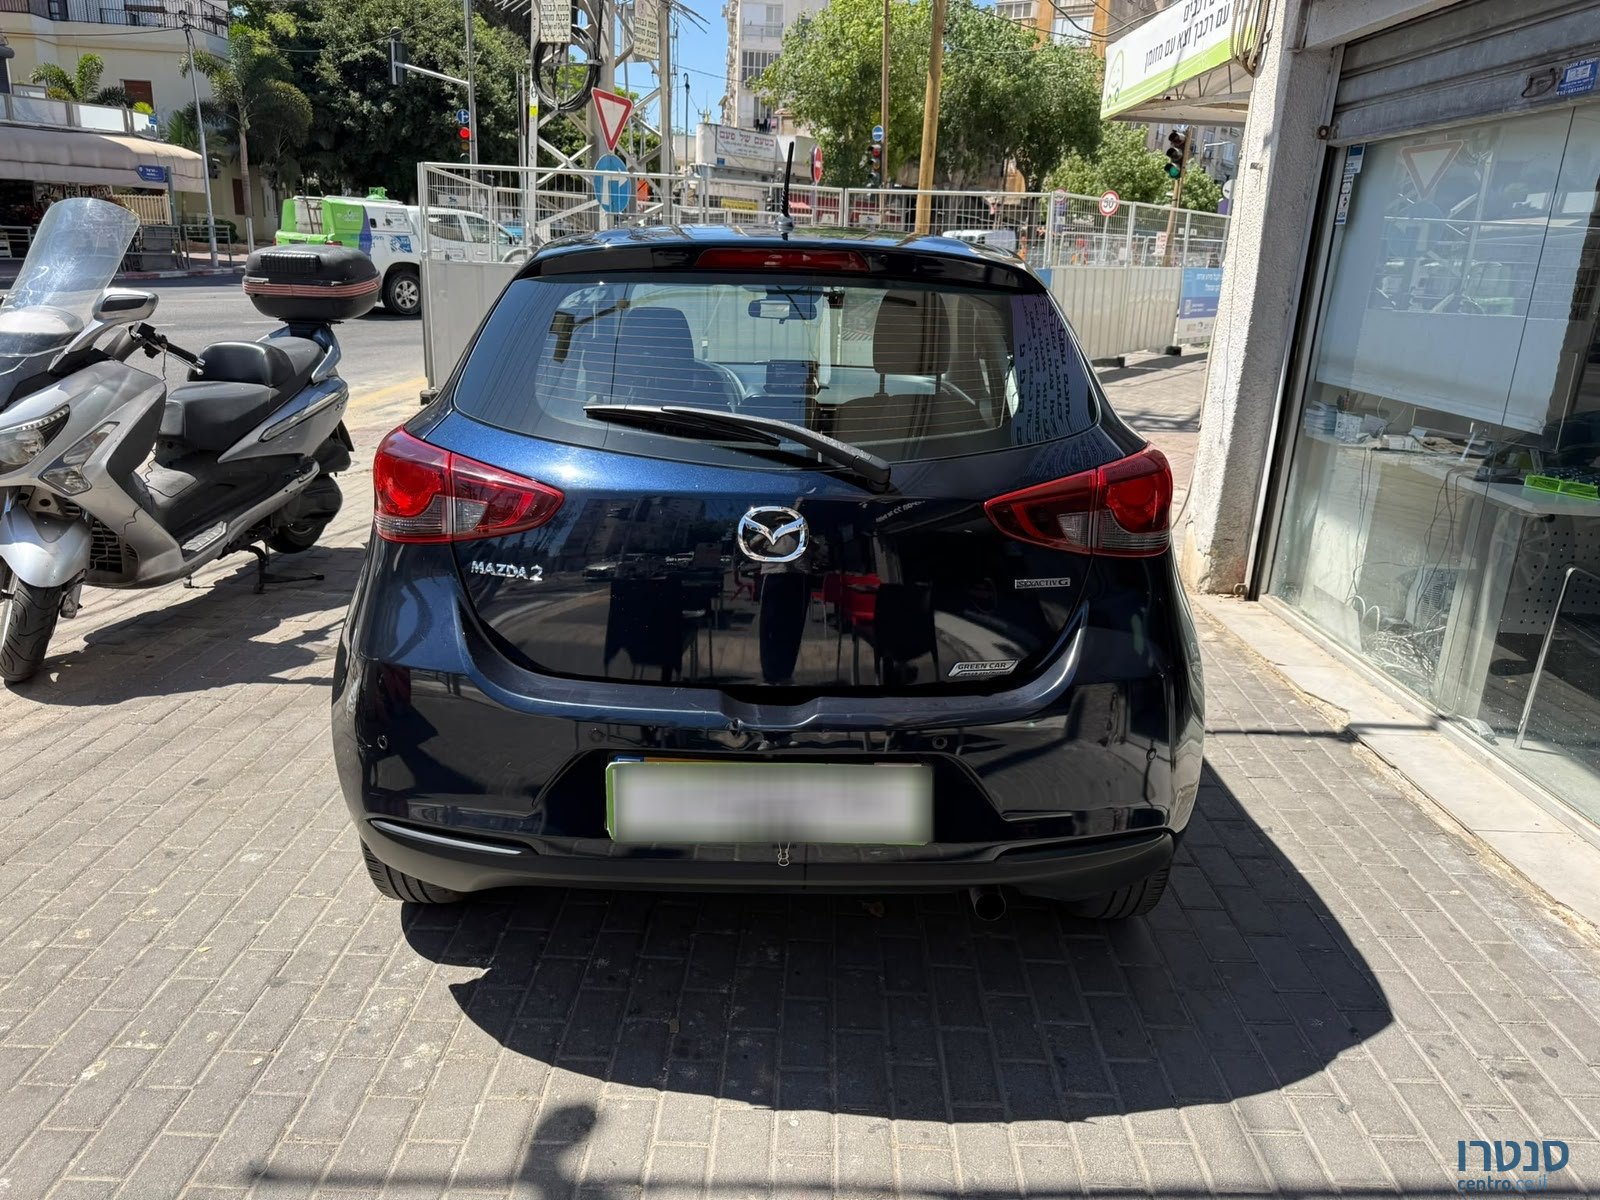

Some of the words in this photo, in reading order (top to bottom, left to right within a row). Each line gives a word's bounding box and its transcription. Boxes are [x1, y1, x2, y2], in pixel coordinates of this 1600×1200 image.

[1215, 3, 1231, 28] עם
[1177, 26, 1192, 51] וצא
[1193, 13, 1214, 47] רכבך
[1164, 34, 1177, 57] עם
[1144, 43, 1163, 73] מזומן
[738, 131, 751, 143] של
[753, 136, 775, 147] בטעם
[1103, 198, 1114, 208] 50
